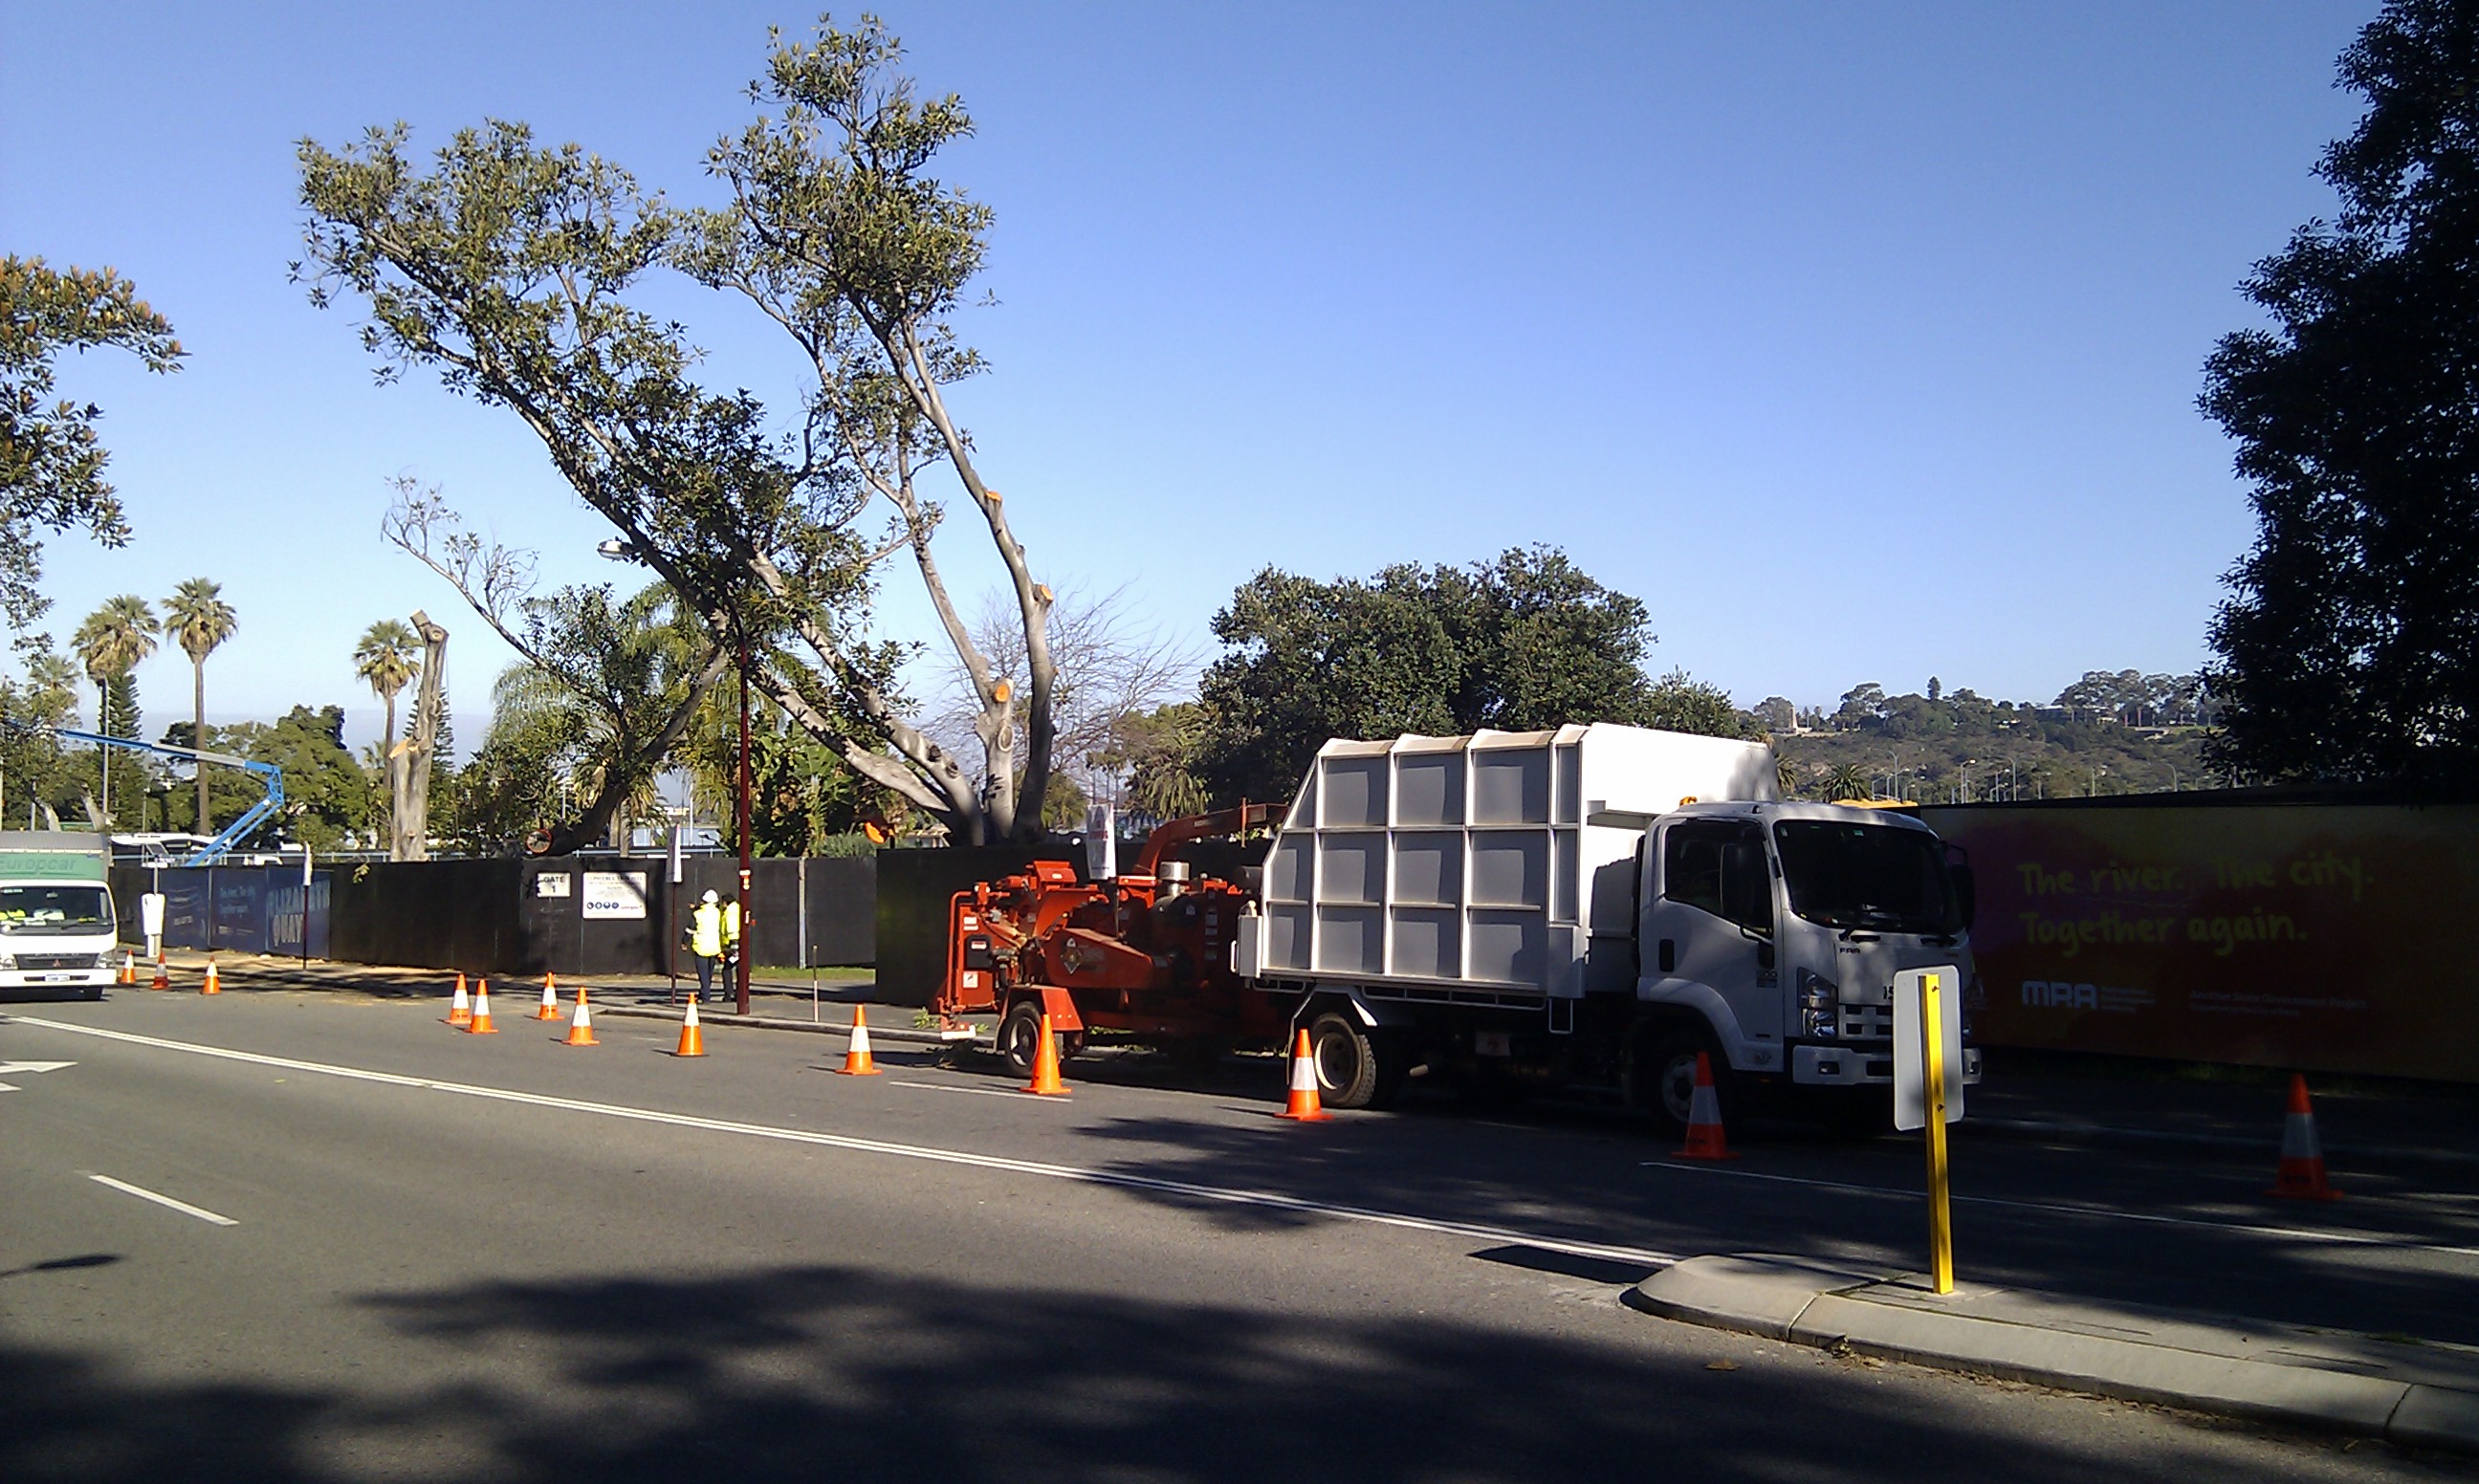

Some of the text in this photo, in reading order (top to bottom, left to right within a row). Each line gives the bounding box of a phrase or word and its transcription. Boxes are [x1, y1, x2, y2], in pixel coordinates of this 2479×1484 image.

[2015, 851, 2375, 903] The river. The city.
[273, 913, 303, 947] QUAY
[2017, 906, 2309, 959] Together again.
[2021, 979, 2098, 1009] MRA
